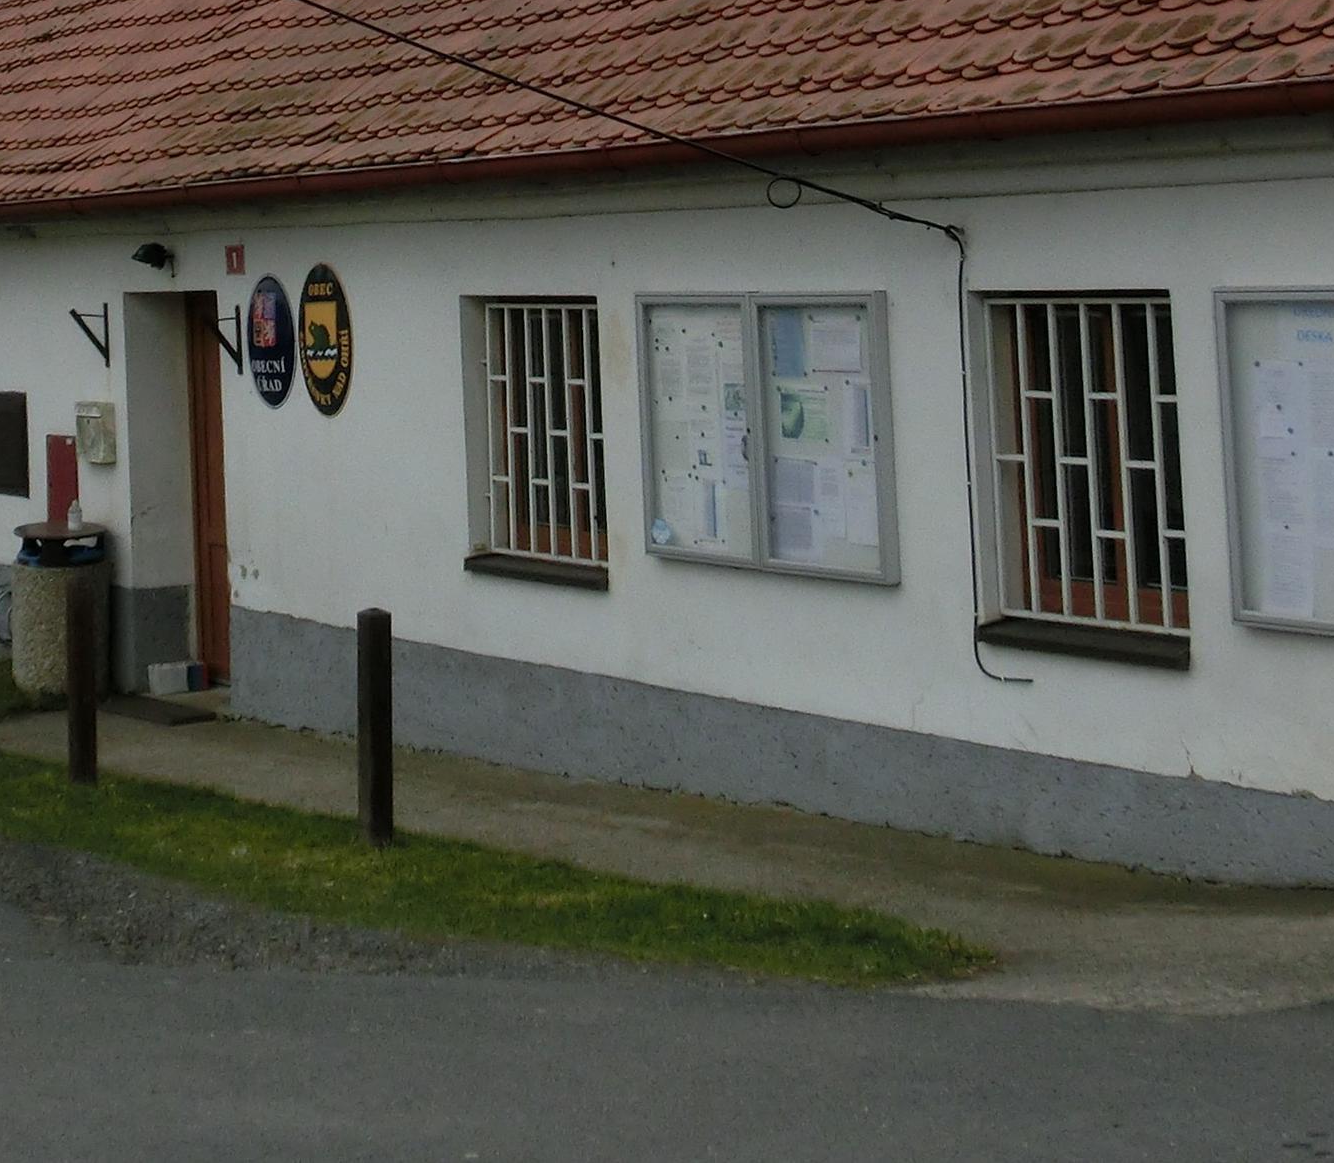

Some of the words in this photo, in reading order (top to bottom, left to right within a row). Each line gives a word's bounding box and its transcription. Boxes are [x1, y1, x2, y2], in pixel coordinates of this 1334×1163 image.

[308, 282, 333, 296] OBEC
[251, 356, 286, 374] OBECNÍ
[257, 375, 282, 392] ÚŘAD
